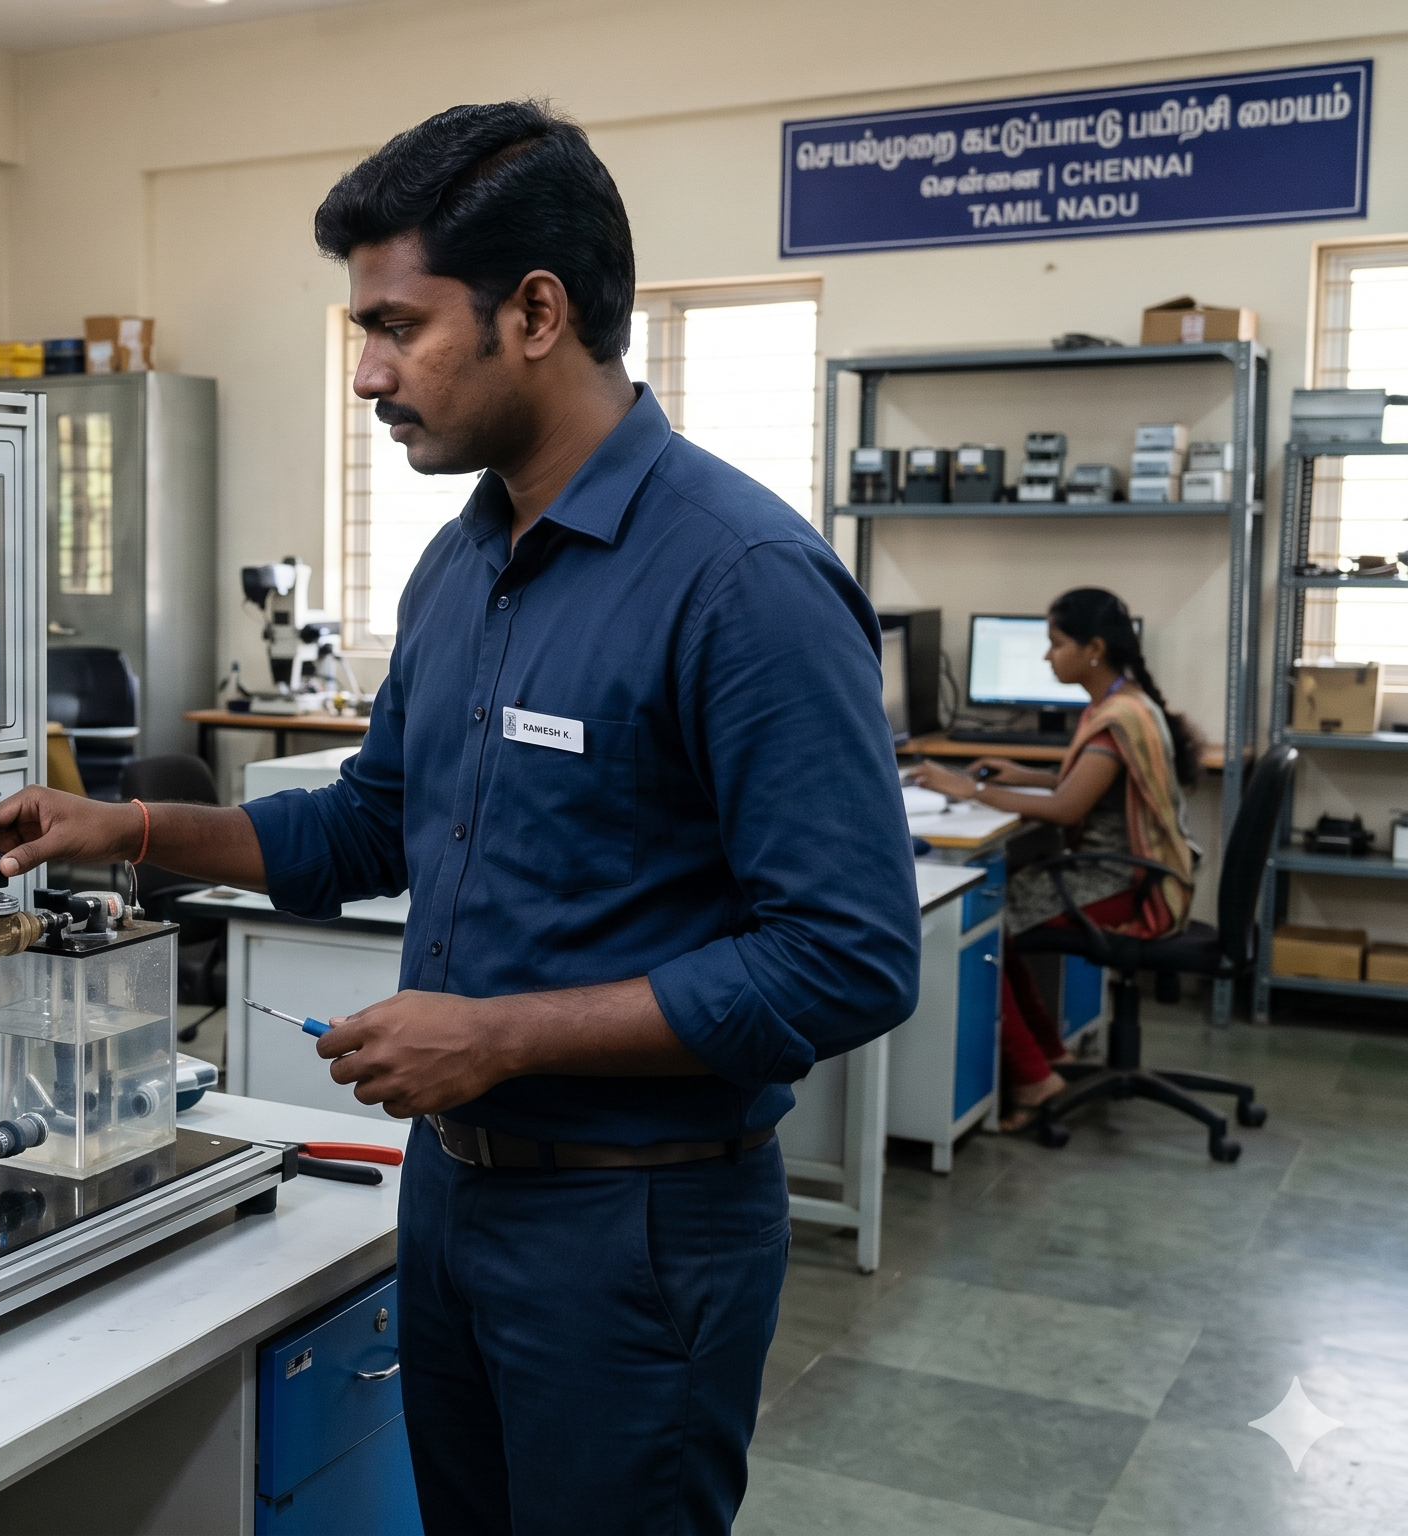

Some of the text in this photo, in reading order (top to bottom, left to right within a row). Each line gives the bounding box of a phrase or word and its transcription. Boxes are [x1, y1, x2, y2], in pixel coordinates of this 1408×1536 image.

[796, 82, 1352, 171] செயல்முறை கட்டுப்பாட்டு பயிற்சி மையம்
[1062, 152, 1193, 186] CHENNAI
[968, 192, 1139, 228] TAMIL NADU
[523, 723, 572, 739] RAMESH K.
